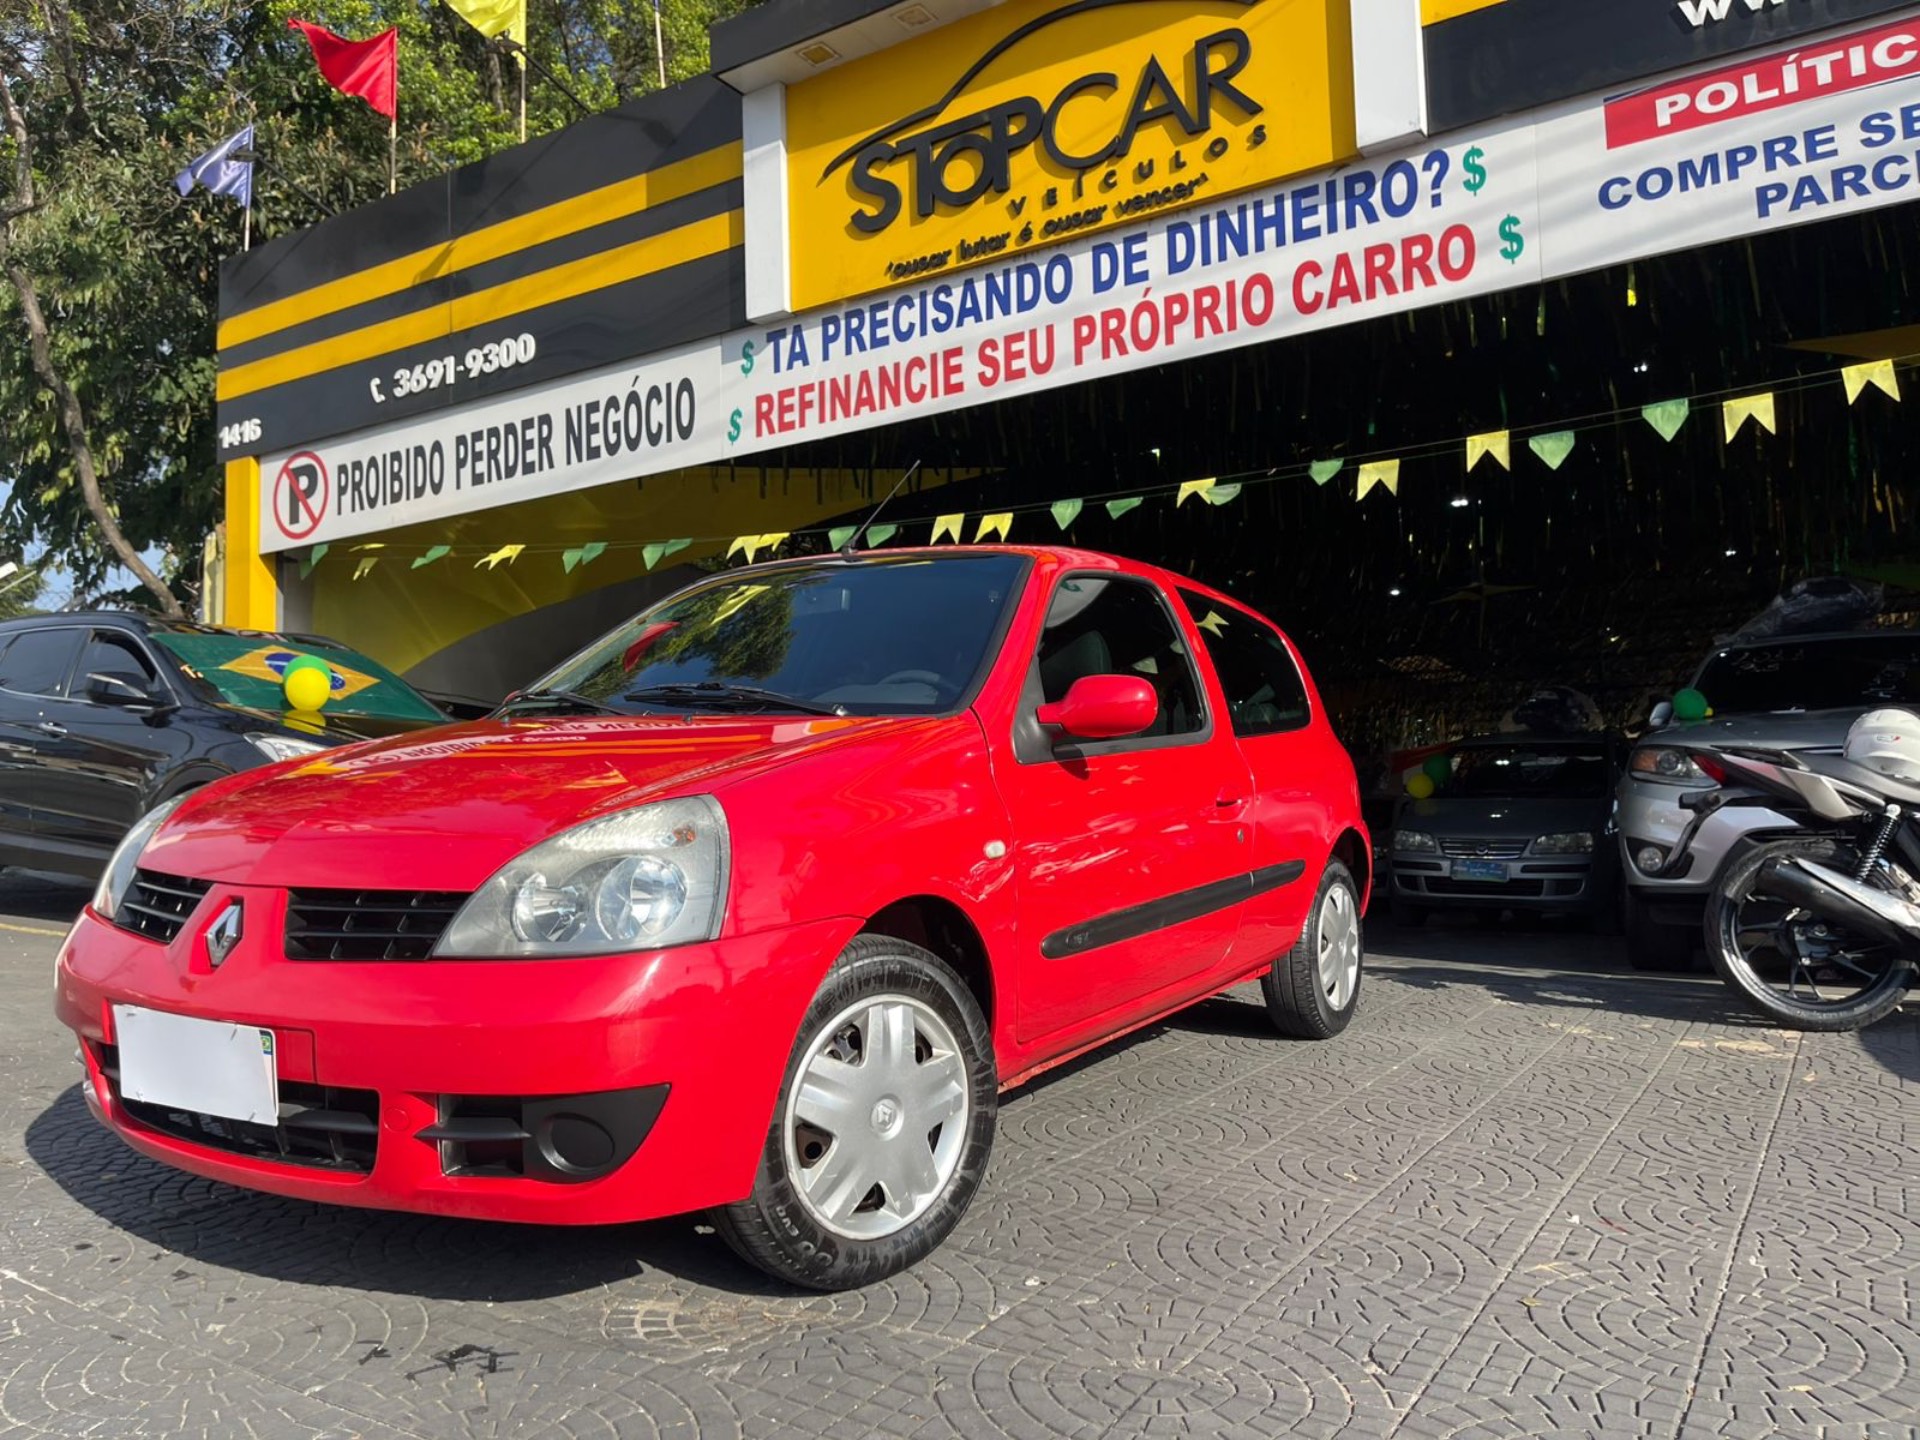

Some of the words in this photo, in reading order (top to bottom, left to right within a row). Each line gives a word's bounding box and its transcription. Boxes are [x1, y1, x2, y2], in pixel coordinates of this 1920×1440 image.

[851, 27, 1265, 233] STOPCAR
[1655, 33, 1918, 128] POLÍTIC
[1010, 124, 1267, 216] VEÍCULOS
[1598, 124, 1839, 210] COMPRE
[1859, 102, 1920, 149] SE
[1755, 150, 1920, 219] PARC
[766, 323, 810, 374] TA
[822, 257, 1073, 361] PRECISANDO
[1092, 232, 1150, 294] DE
[1167, 149, 1450, 274] DINHEIRO?
[960, 231, 1011, 260] lutar
[1020, 221, 1033, 242] é
[1043, 204, 1108, 235] ousar
[392, 333, 536, 398] 3691-9300
[756, 346, 966, 438] REFINANCIE
[978, 325, 1055, 388] SEU
[1074, 273, 1275, 366] PRÓPRIO
[1292, 225, 1476, 314] CARRO
[336, 440, 445, 516] PROIBIDO
[455, 413, 555, 490] PERDER
[565, 376, 695, 466] NEGÓCIO
